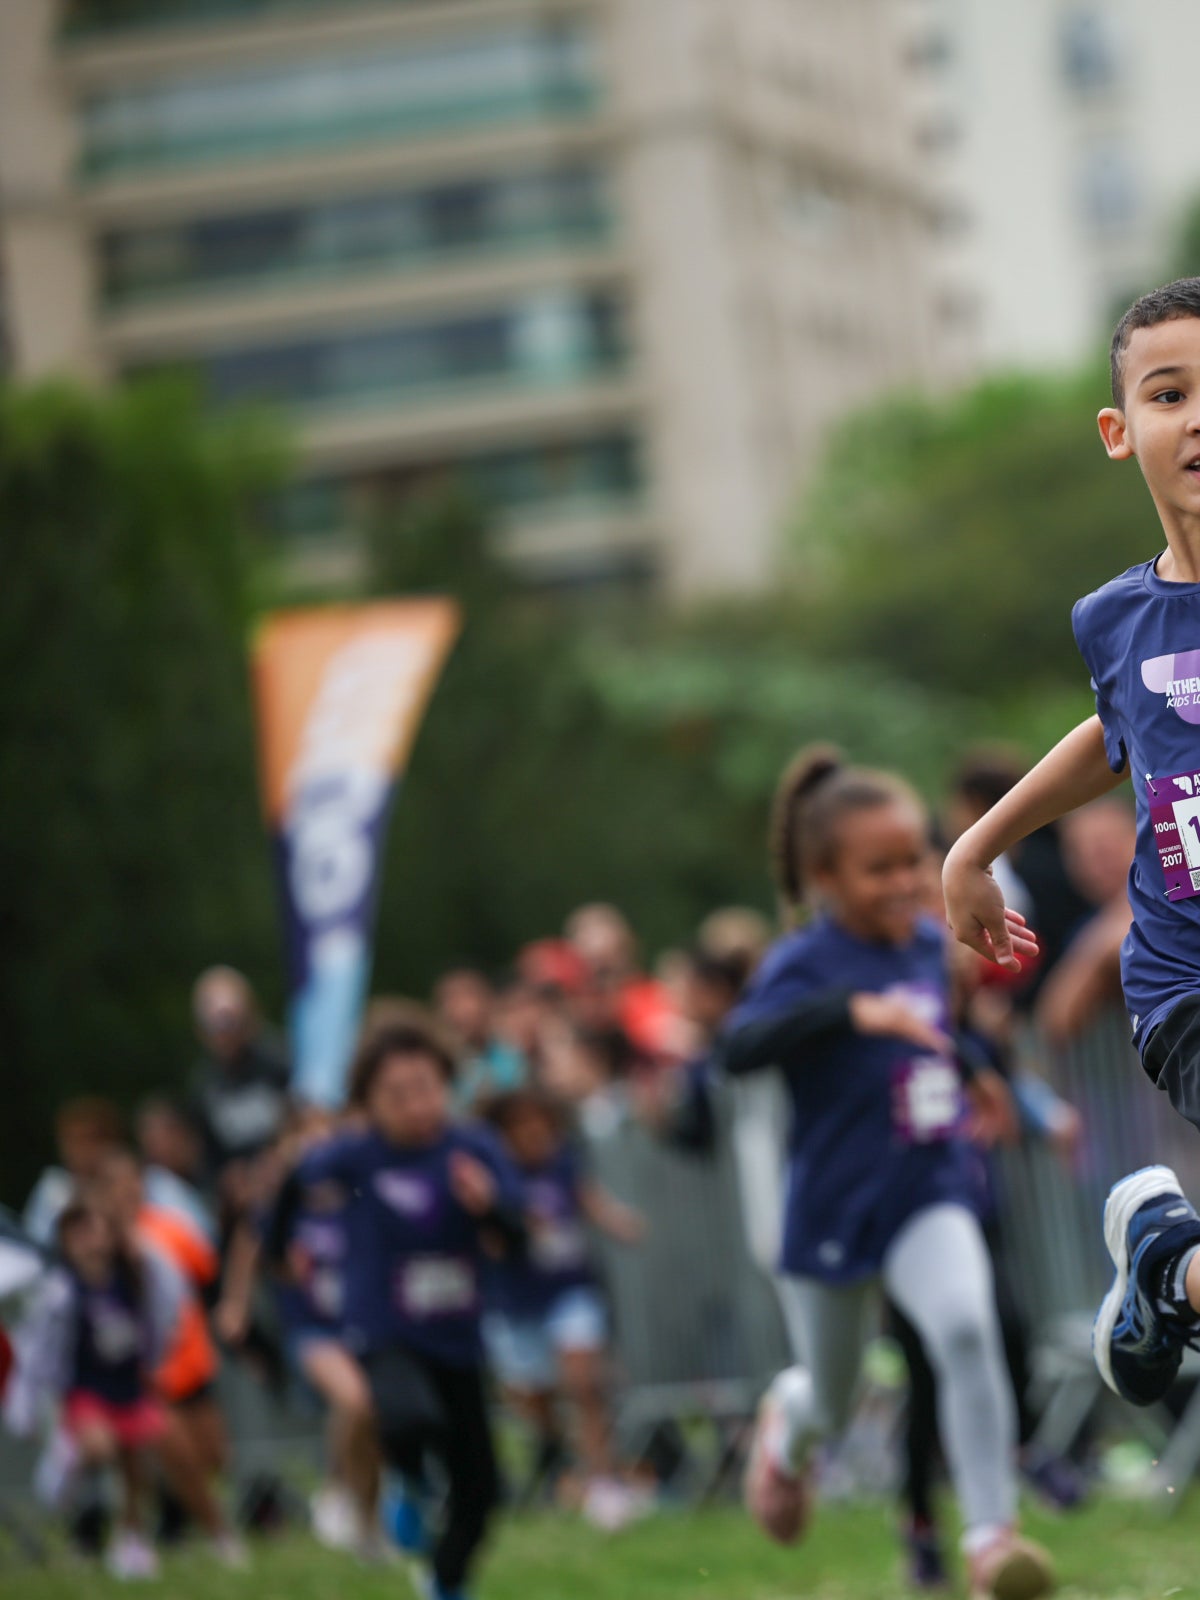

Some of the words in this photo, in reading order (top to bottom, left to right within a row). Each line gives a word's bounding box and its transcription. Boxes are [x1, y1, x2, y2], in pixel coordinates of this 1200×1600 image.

[1166, 696, 1190, 708] KIDS
[1154, 821, 1177, 834] 100m
[1162, 852, 1183, 868] 2017
